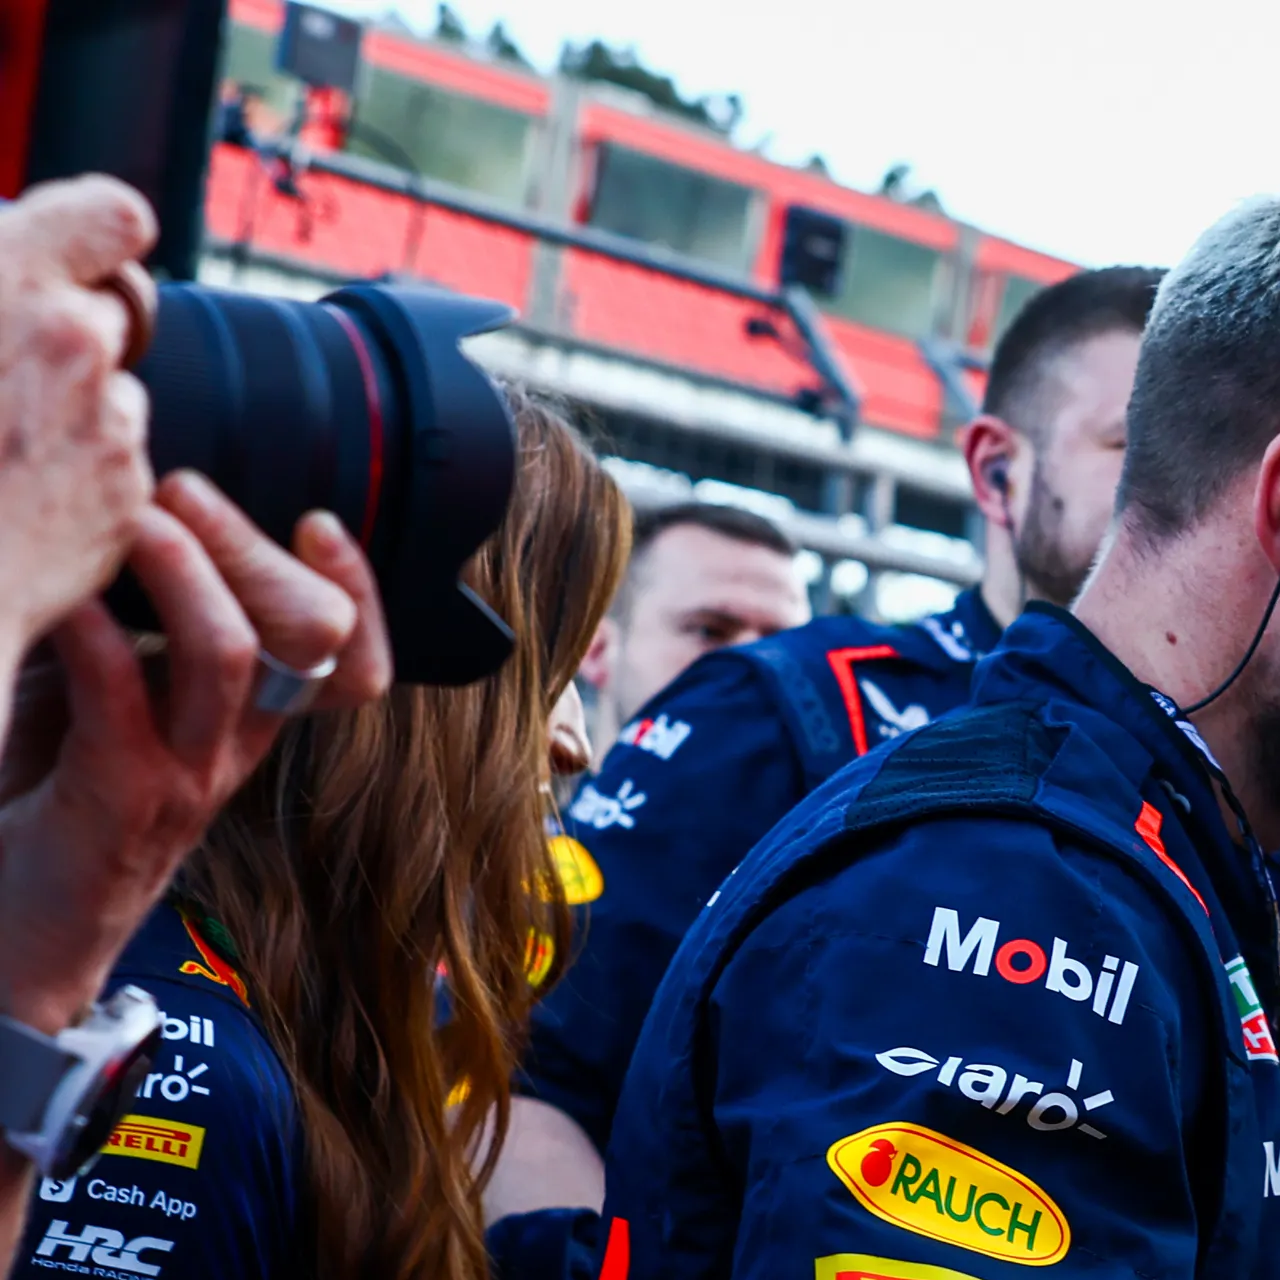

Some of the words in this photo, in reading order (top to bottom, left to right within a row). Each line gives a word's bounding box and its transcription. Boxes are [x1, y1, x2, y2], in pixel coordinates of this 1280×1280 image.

[923, 906, 1139, 1024] Mobil
[162, 1011, 215, 1048] bil
[107, 1122, 192, 1158] RELLI
[86, 1178, 146, 1207] Cash
[149, 1189, 198, 1221] App
[890, 1152, 1042, 1251] RAUCH
[30, 1255, 91, 1275] Honda
[35, 1218, 176, 1277] HRC
